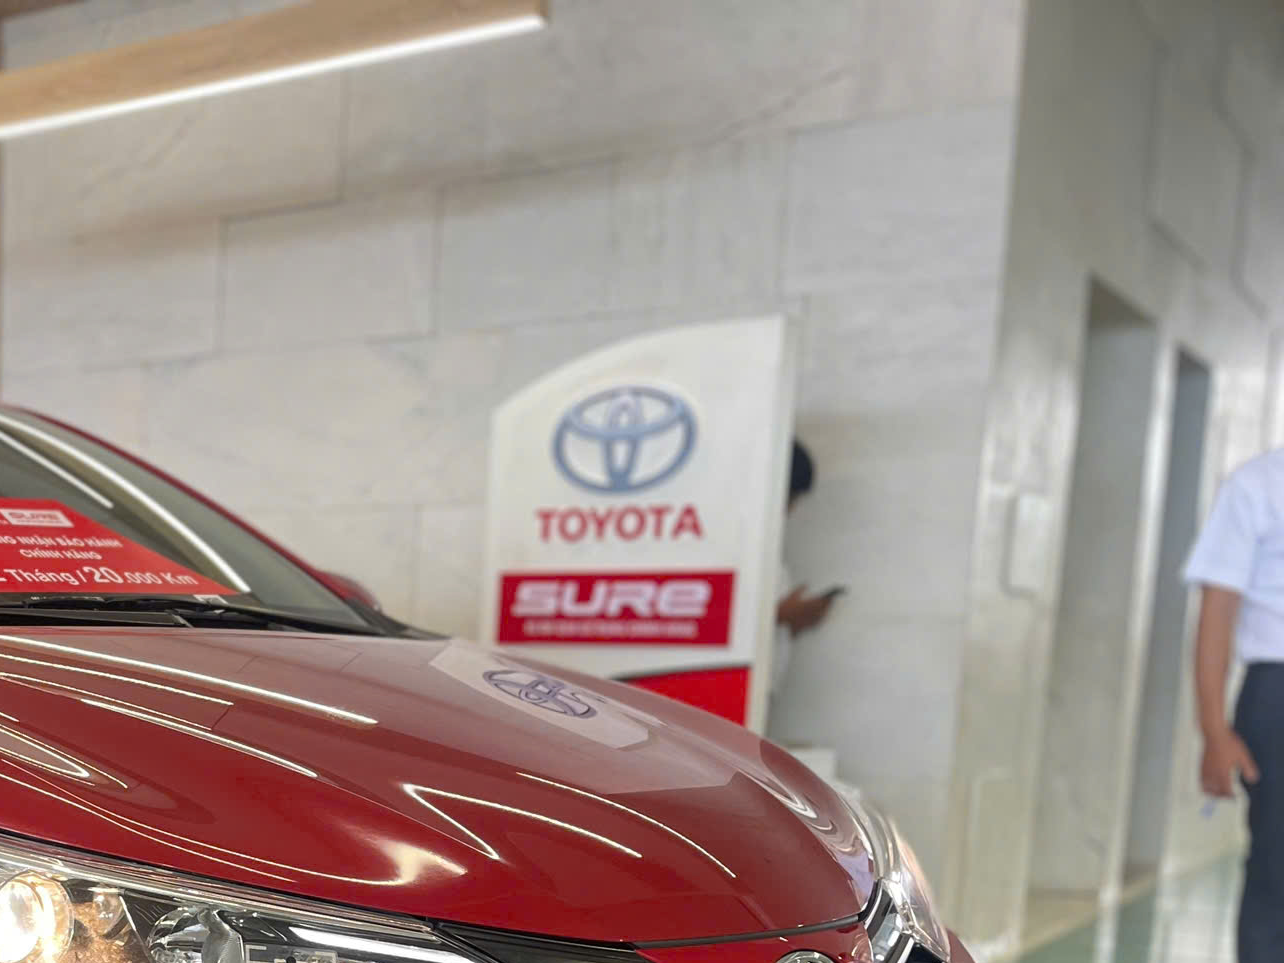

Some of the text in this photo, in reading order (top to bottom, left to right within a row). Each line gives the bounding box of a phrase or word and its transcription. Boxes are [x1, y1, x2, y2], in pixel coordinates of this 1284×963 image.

[536, 503, 703, 542] TOYOTA
[4, 569, 80, 586] Tháng
[160, 572, 198, 585] Km
[511, 579, 711, 617] SURE
